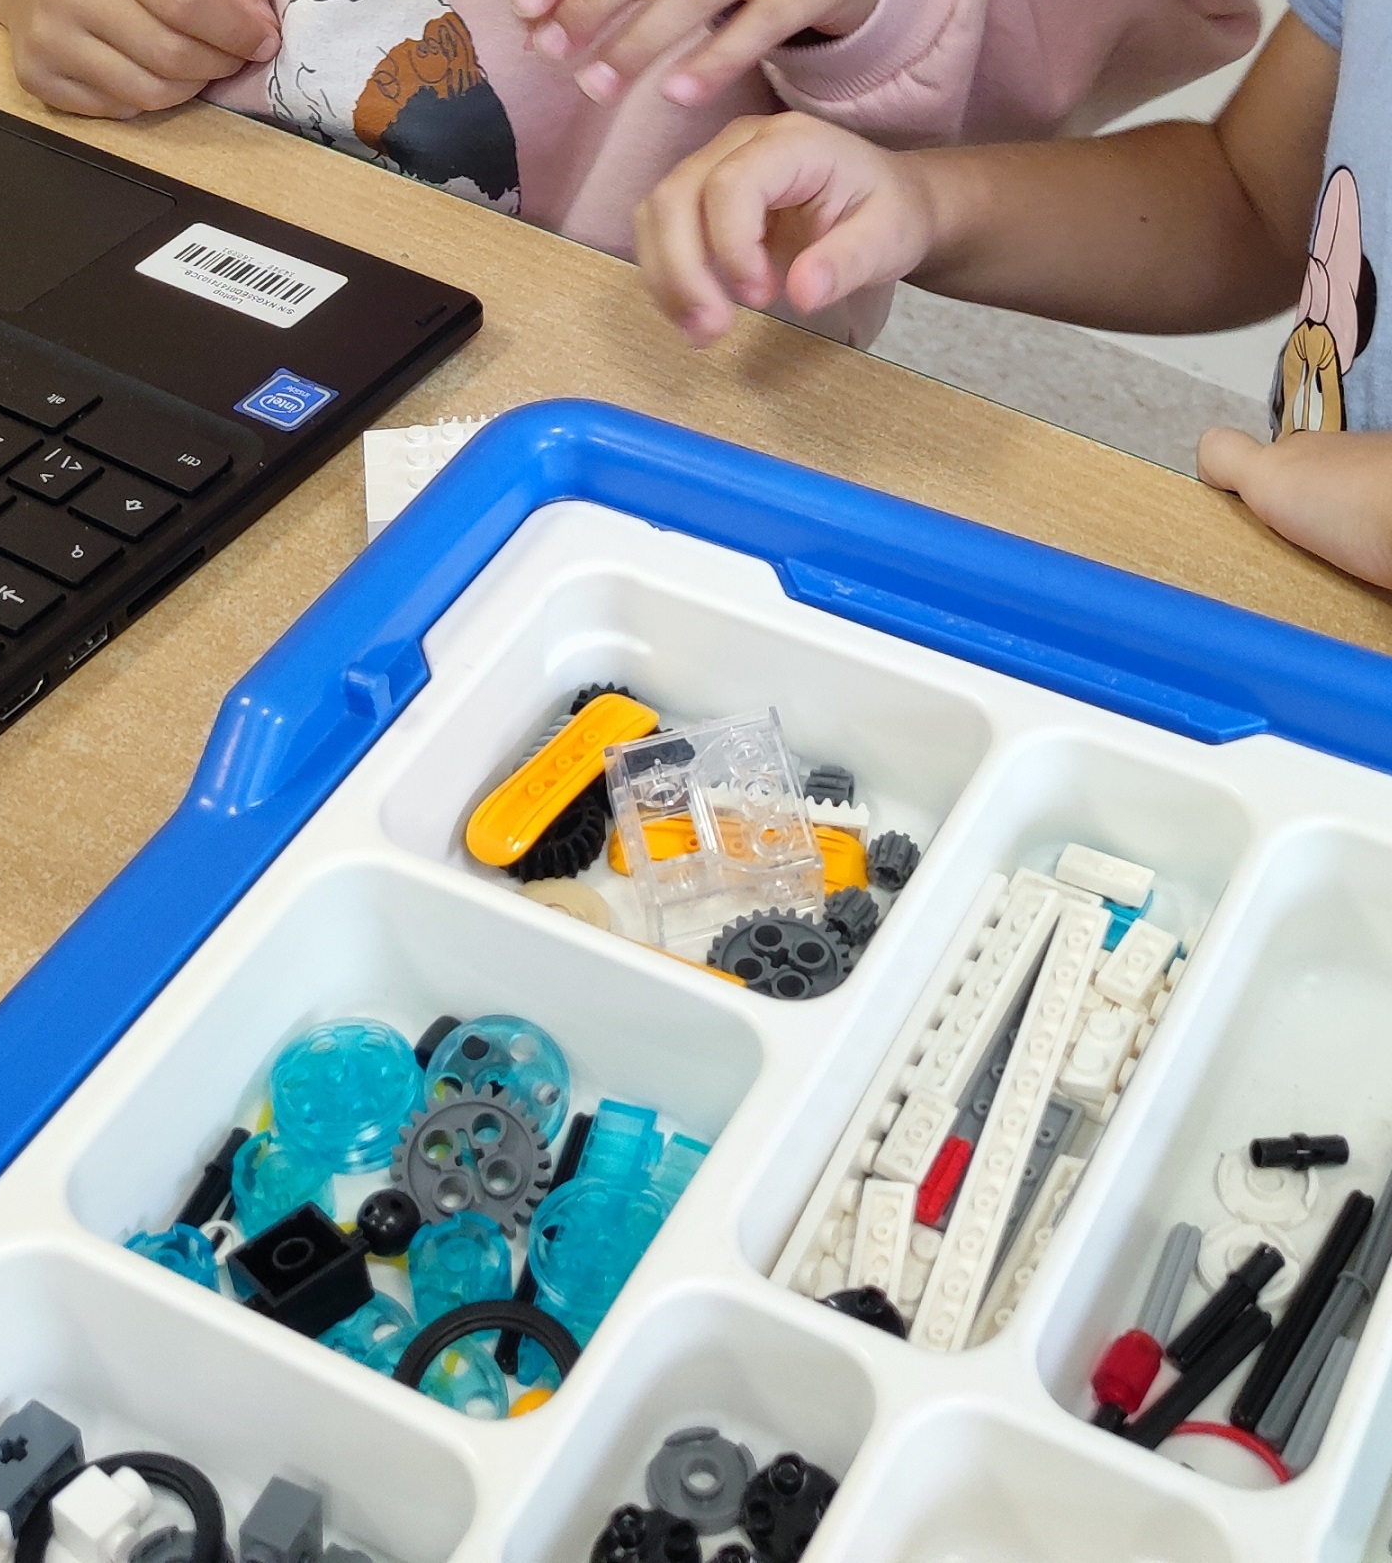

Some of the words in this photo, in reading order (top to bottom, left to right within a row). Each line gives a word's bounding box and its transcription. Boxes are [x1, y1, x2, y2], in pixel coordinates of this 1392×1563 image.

[46, 393, 66, 405] alt
[265, 395, 298, 414] intel
[177, 453, 201, 467] ctrl
